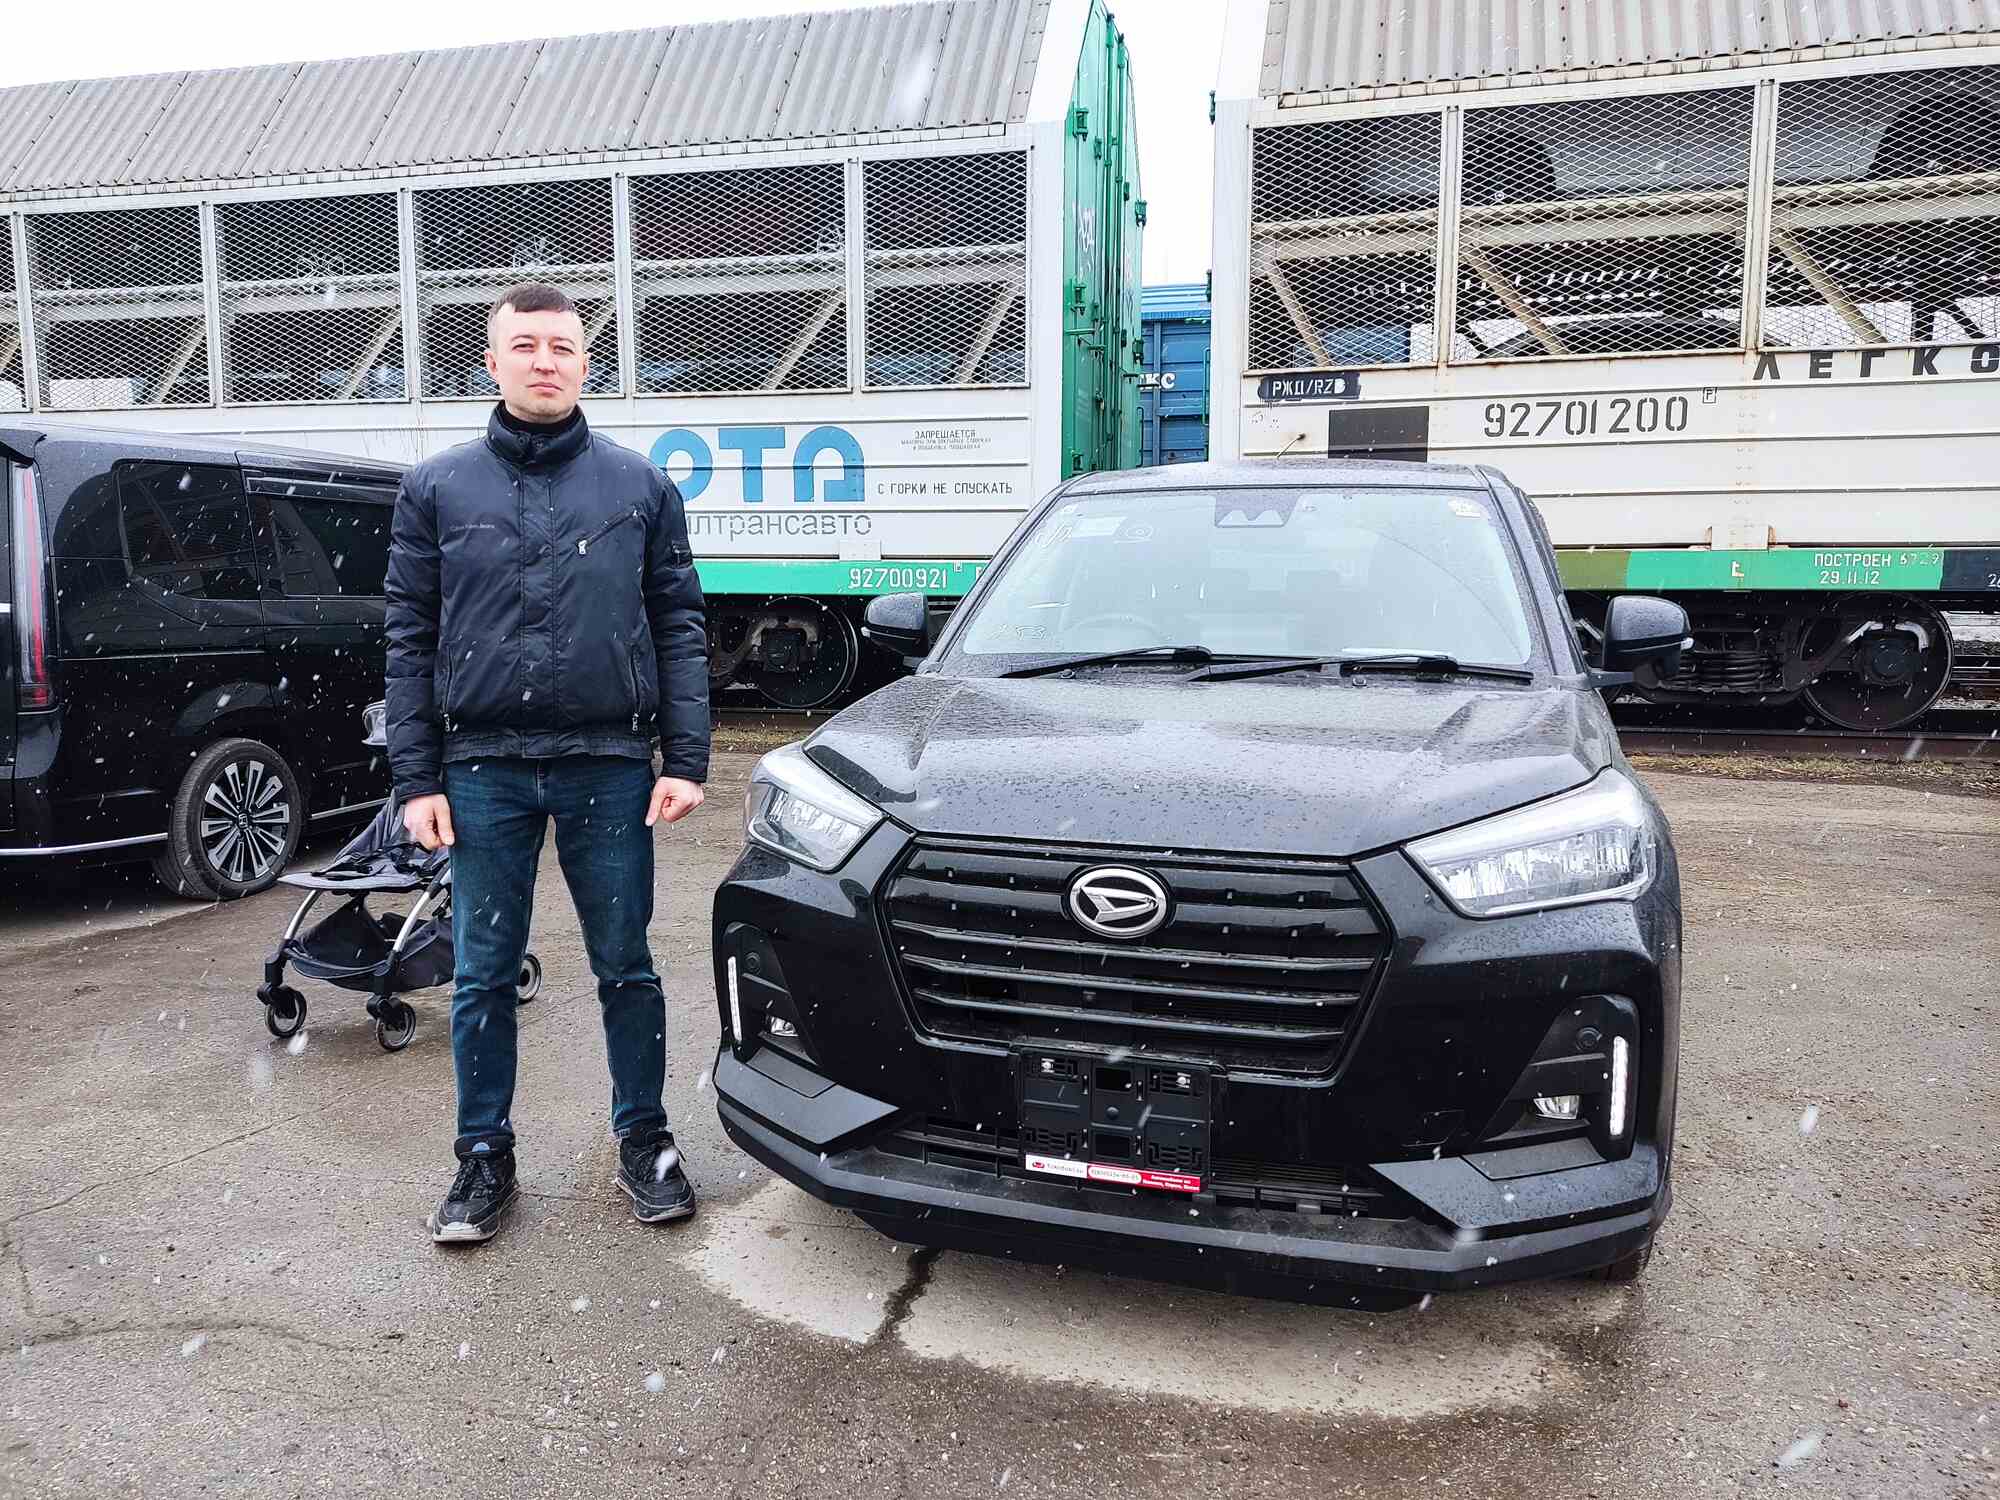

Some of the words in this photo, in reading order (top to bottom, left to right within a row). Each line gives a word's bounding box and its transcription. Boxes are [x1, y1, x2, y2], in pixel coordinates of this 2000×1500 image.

[1483, 396, 1688, 438] 92701200
[890, 483, 927, 495] ГОРКИ
[933, 482, 947, 494] НЕ
[954, 482, 1013, 494] СПУСКАТЬ
[1814, 553, 1892, 568] ПОСТРОЕН
[848, 567, 948, 589] 92700921
[1820, 570, 1880, 585] 29.11.12
